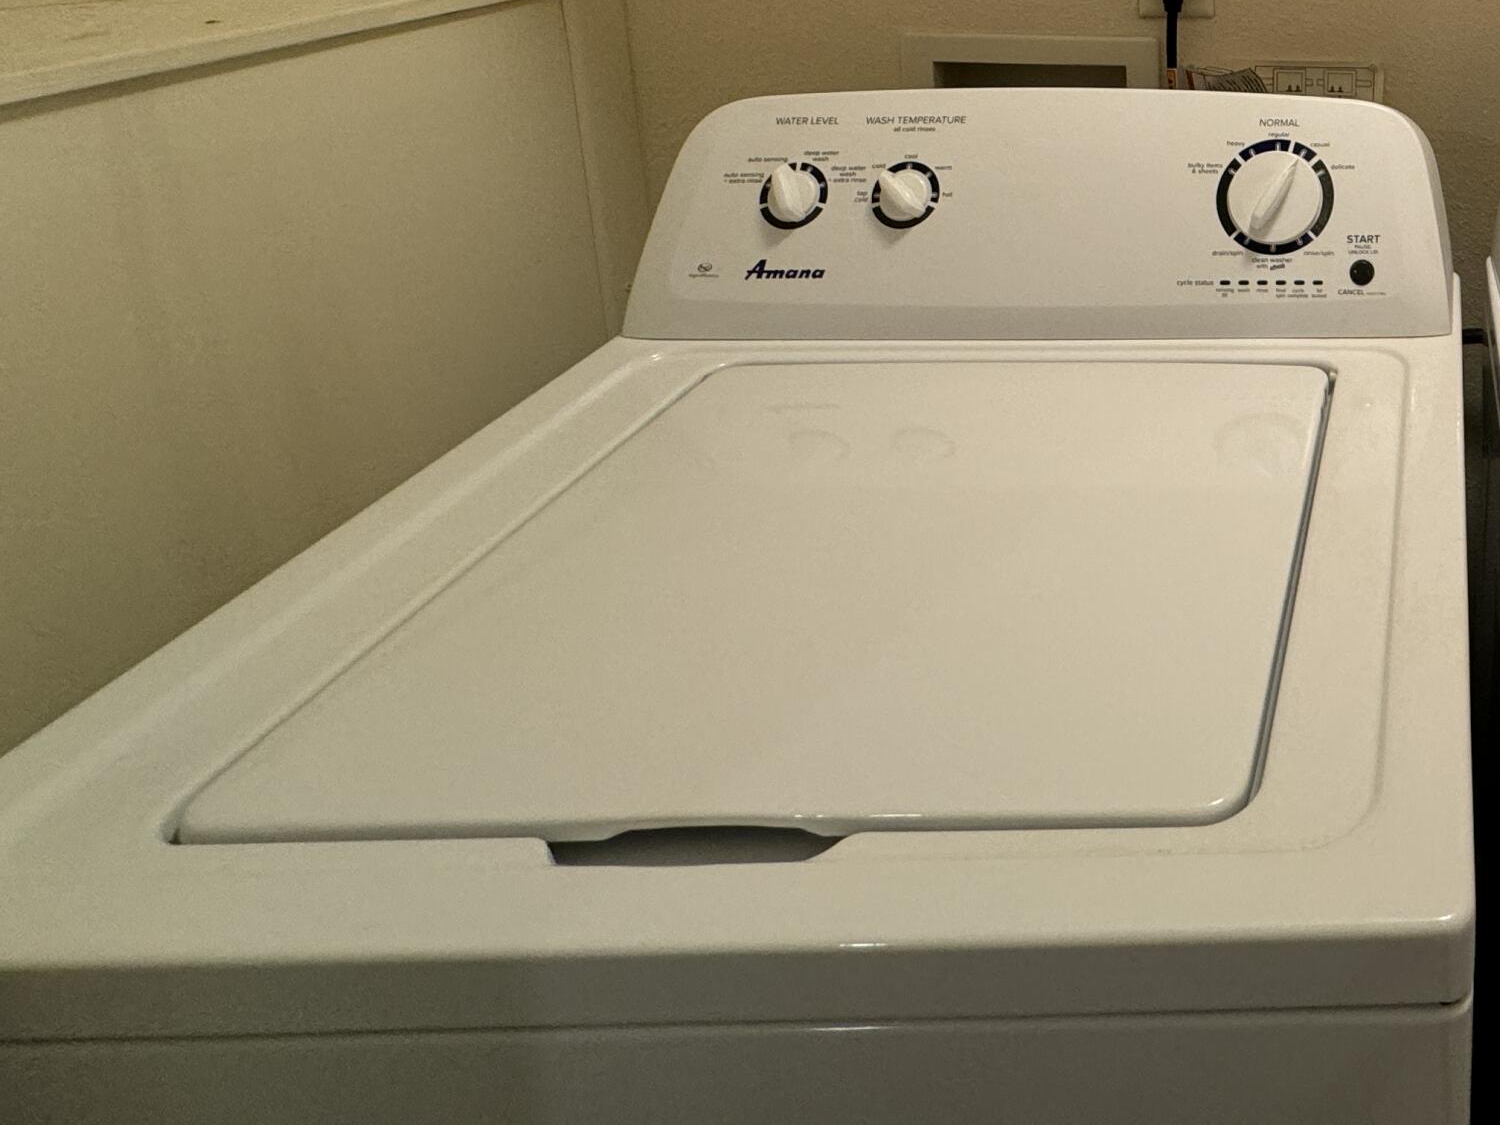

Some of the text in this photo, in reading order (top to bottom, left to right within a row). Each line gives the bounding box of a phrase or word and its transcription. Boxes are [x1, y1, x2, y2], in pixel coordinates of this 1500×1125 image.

[776, 116, 839, 125] WATER LEVEL
[866, 115, 967, 125] WASH TEMPERATURE
[1346, 234, 1381, 244] START
[744, 259, 826, 281] Amana
